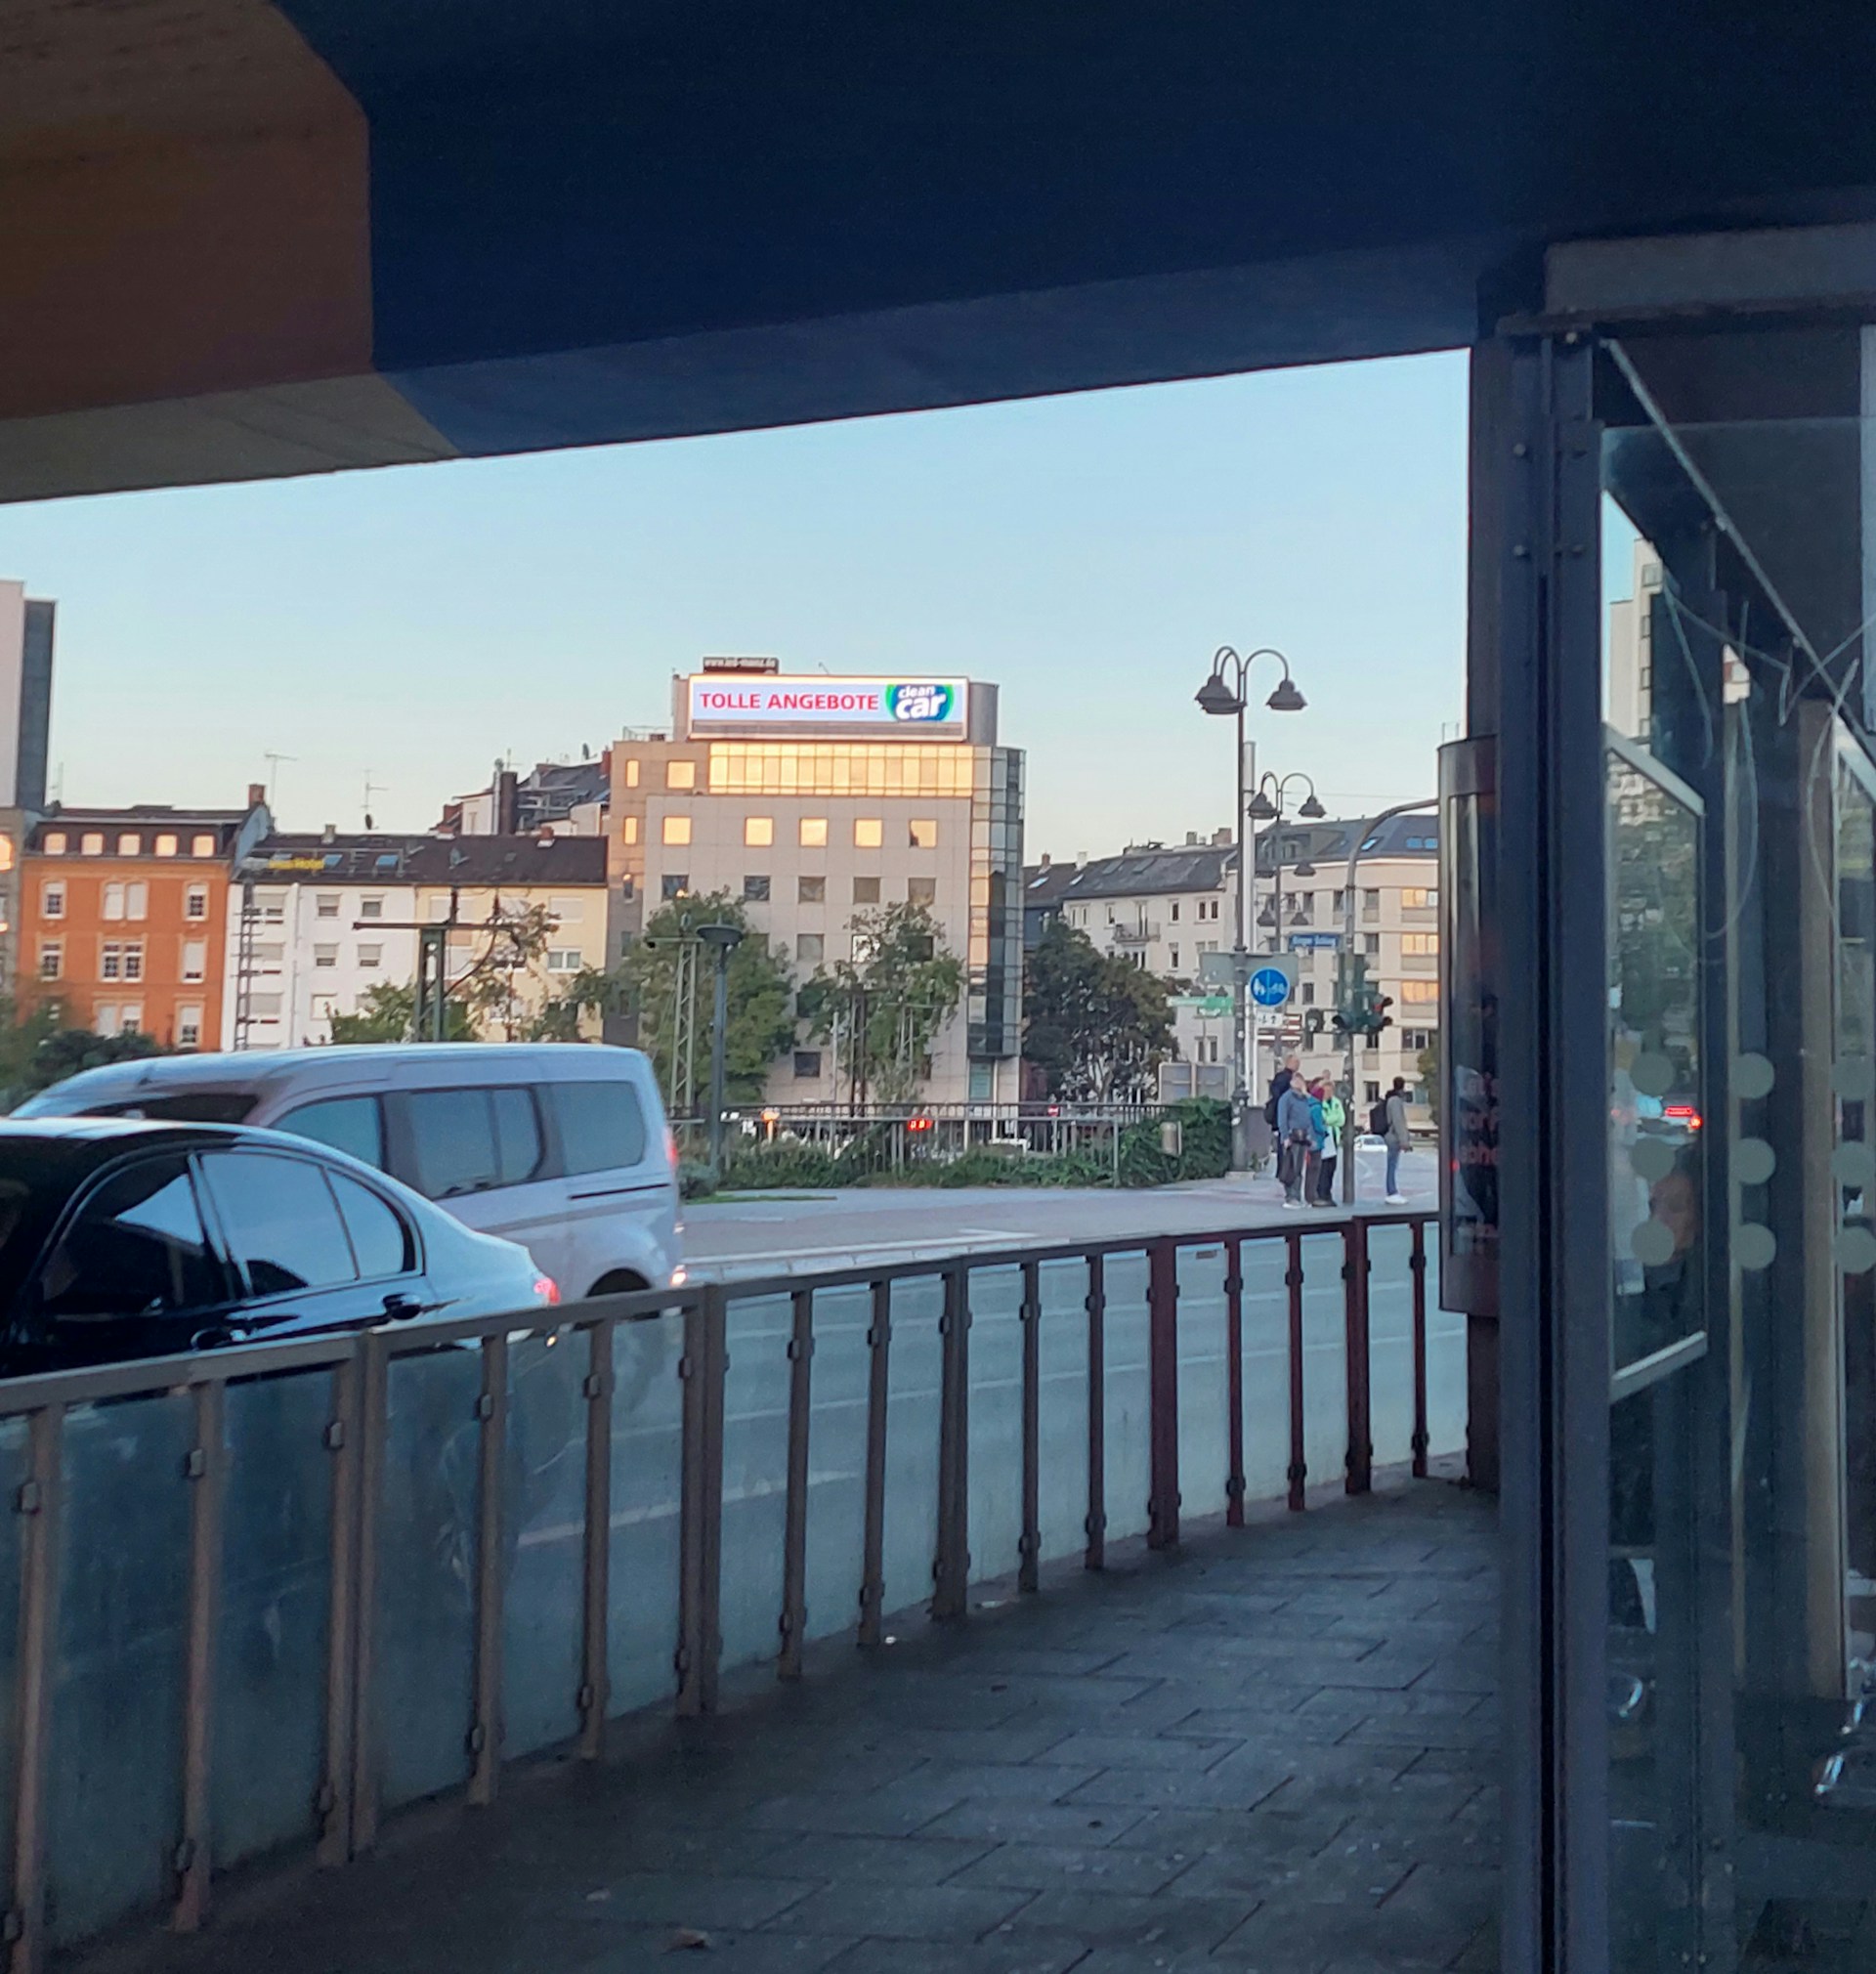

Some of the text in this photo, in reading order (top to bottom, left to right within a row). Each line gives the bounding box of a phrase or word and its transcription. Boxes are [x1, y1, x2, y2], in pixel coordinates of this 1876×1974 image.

[898, 685, 935, 699] clean
[701, 693, 878, 710] TOLLE ANGEBOTE
[895, 695, 947, 720] car
